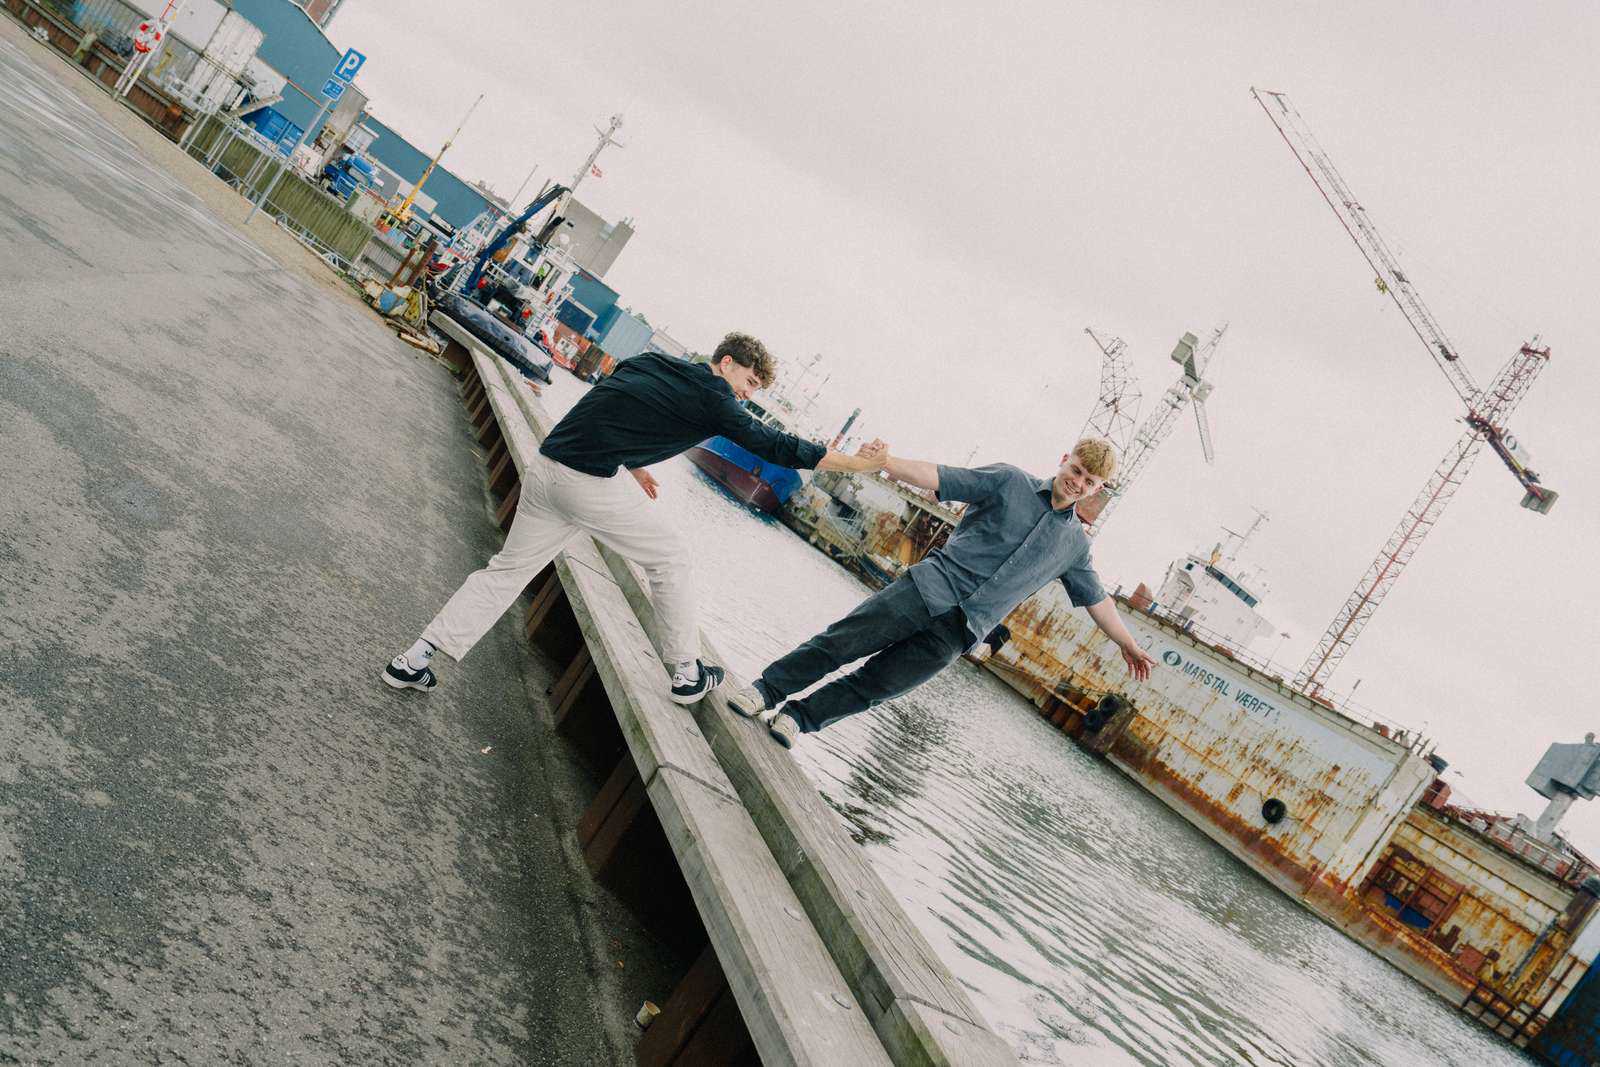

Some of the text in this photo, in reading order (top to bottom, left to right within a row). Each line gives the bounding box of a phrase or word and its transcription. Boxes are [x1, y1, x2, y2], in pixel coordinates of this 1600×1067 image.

[339, 53, 360, 75] P
[1183, 661, 1275, 717] MARSTAL VÆRFT
